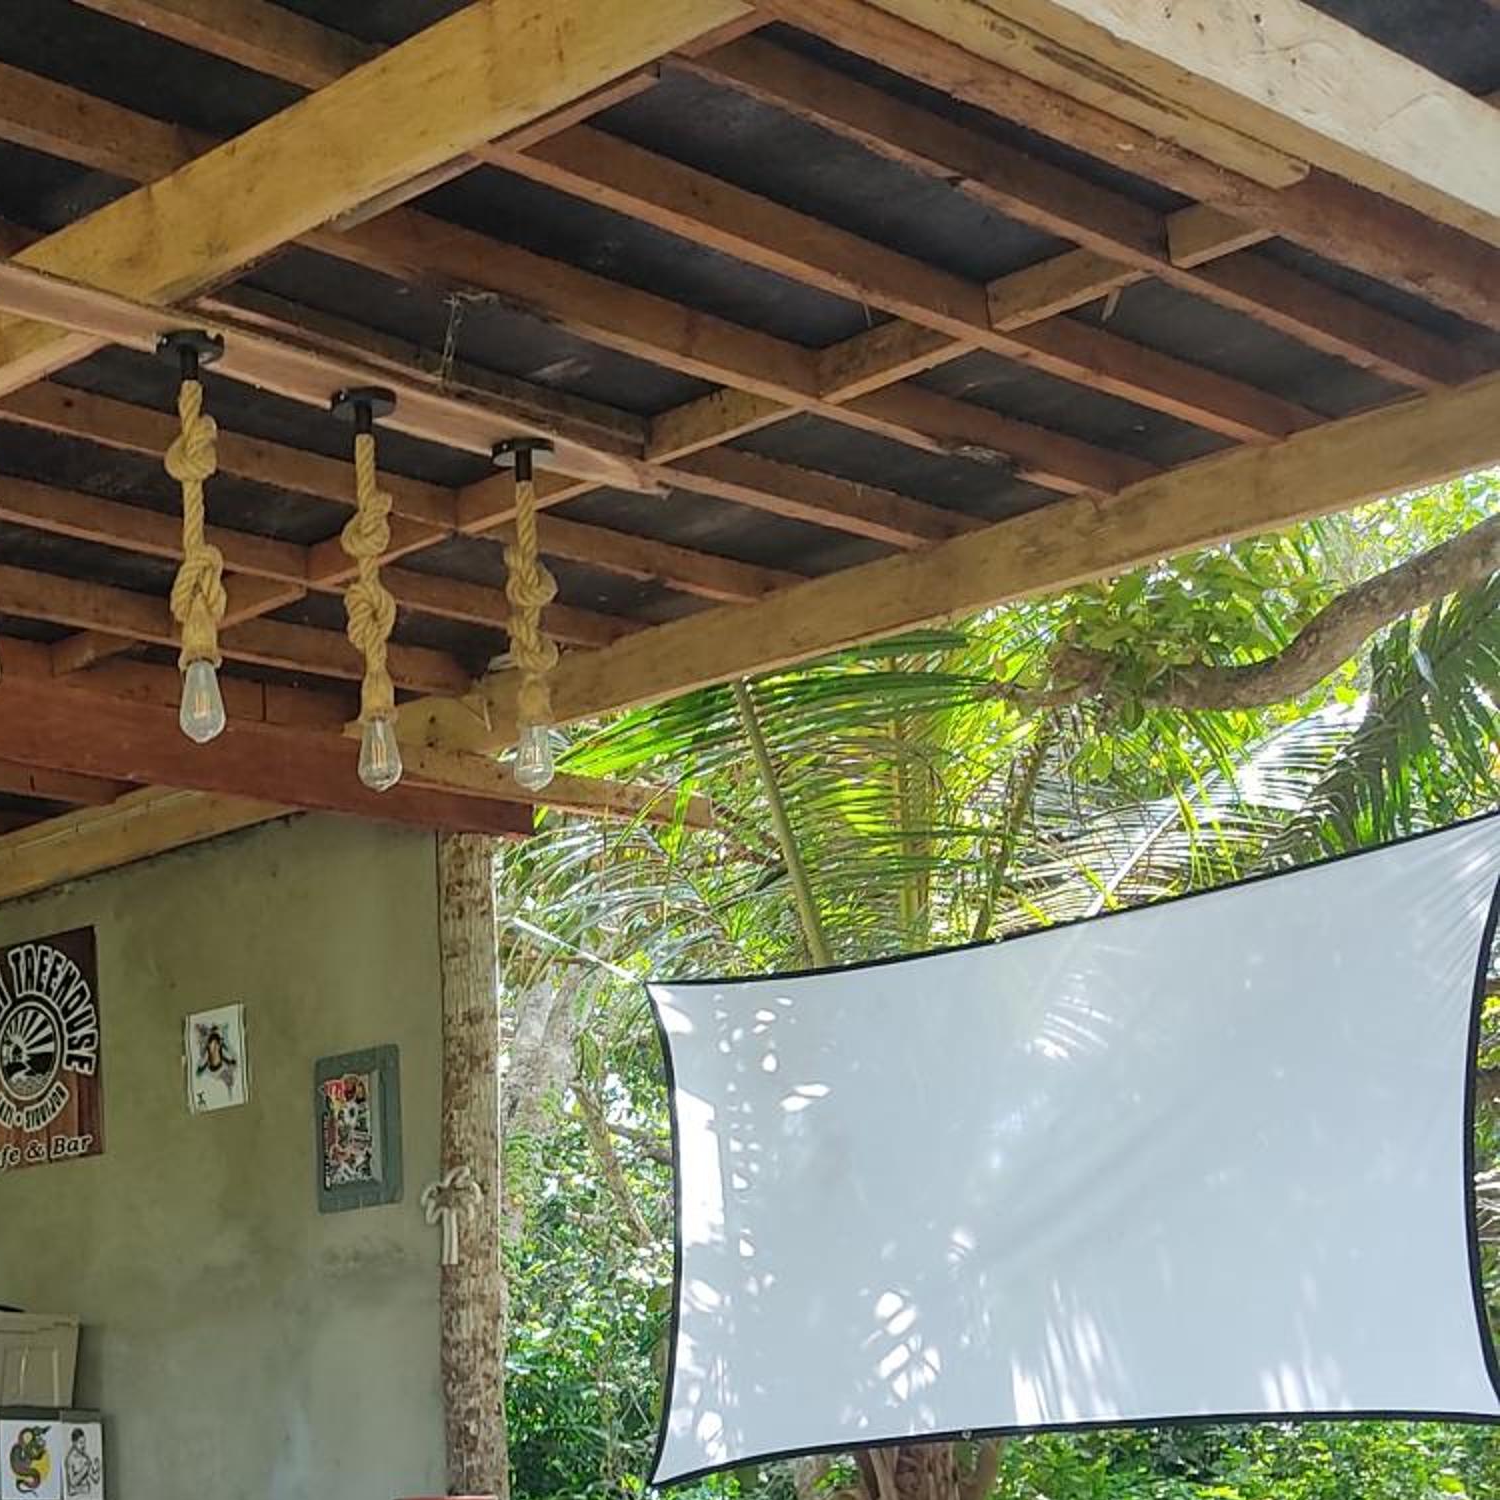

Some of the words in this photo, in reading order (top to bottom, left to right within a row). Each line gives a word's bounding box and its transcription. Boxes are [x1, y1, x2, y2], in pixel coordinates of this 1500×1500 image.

[9, 945, 97, 1073] TREEHOUSE
[27, 1141, 45, 1161] &
[52, 1135, 92, 1157] Bar
